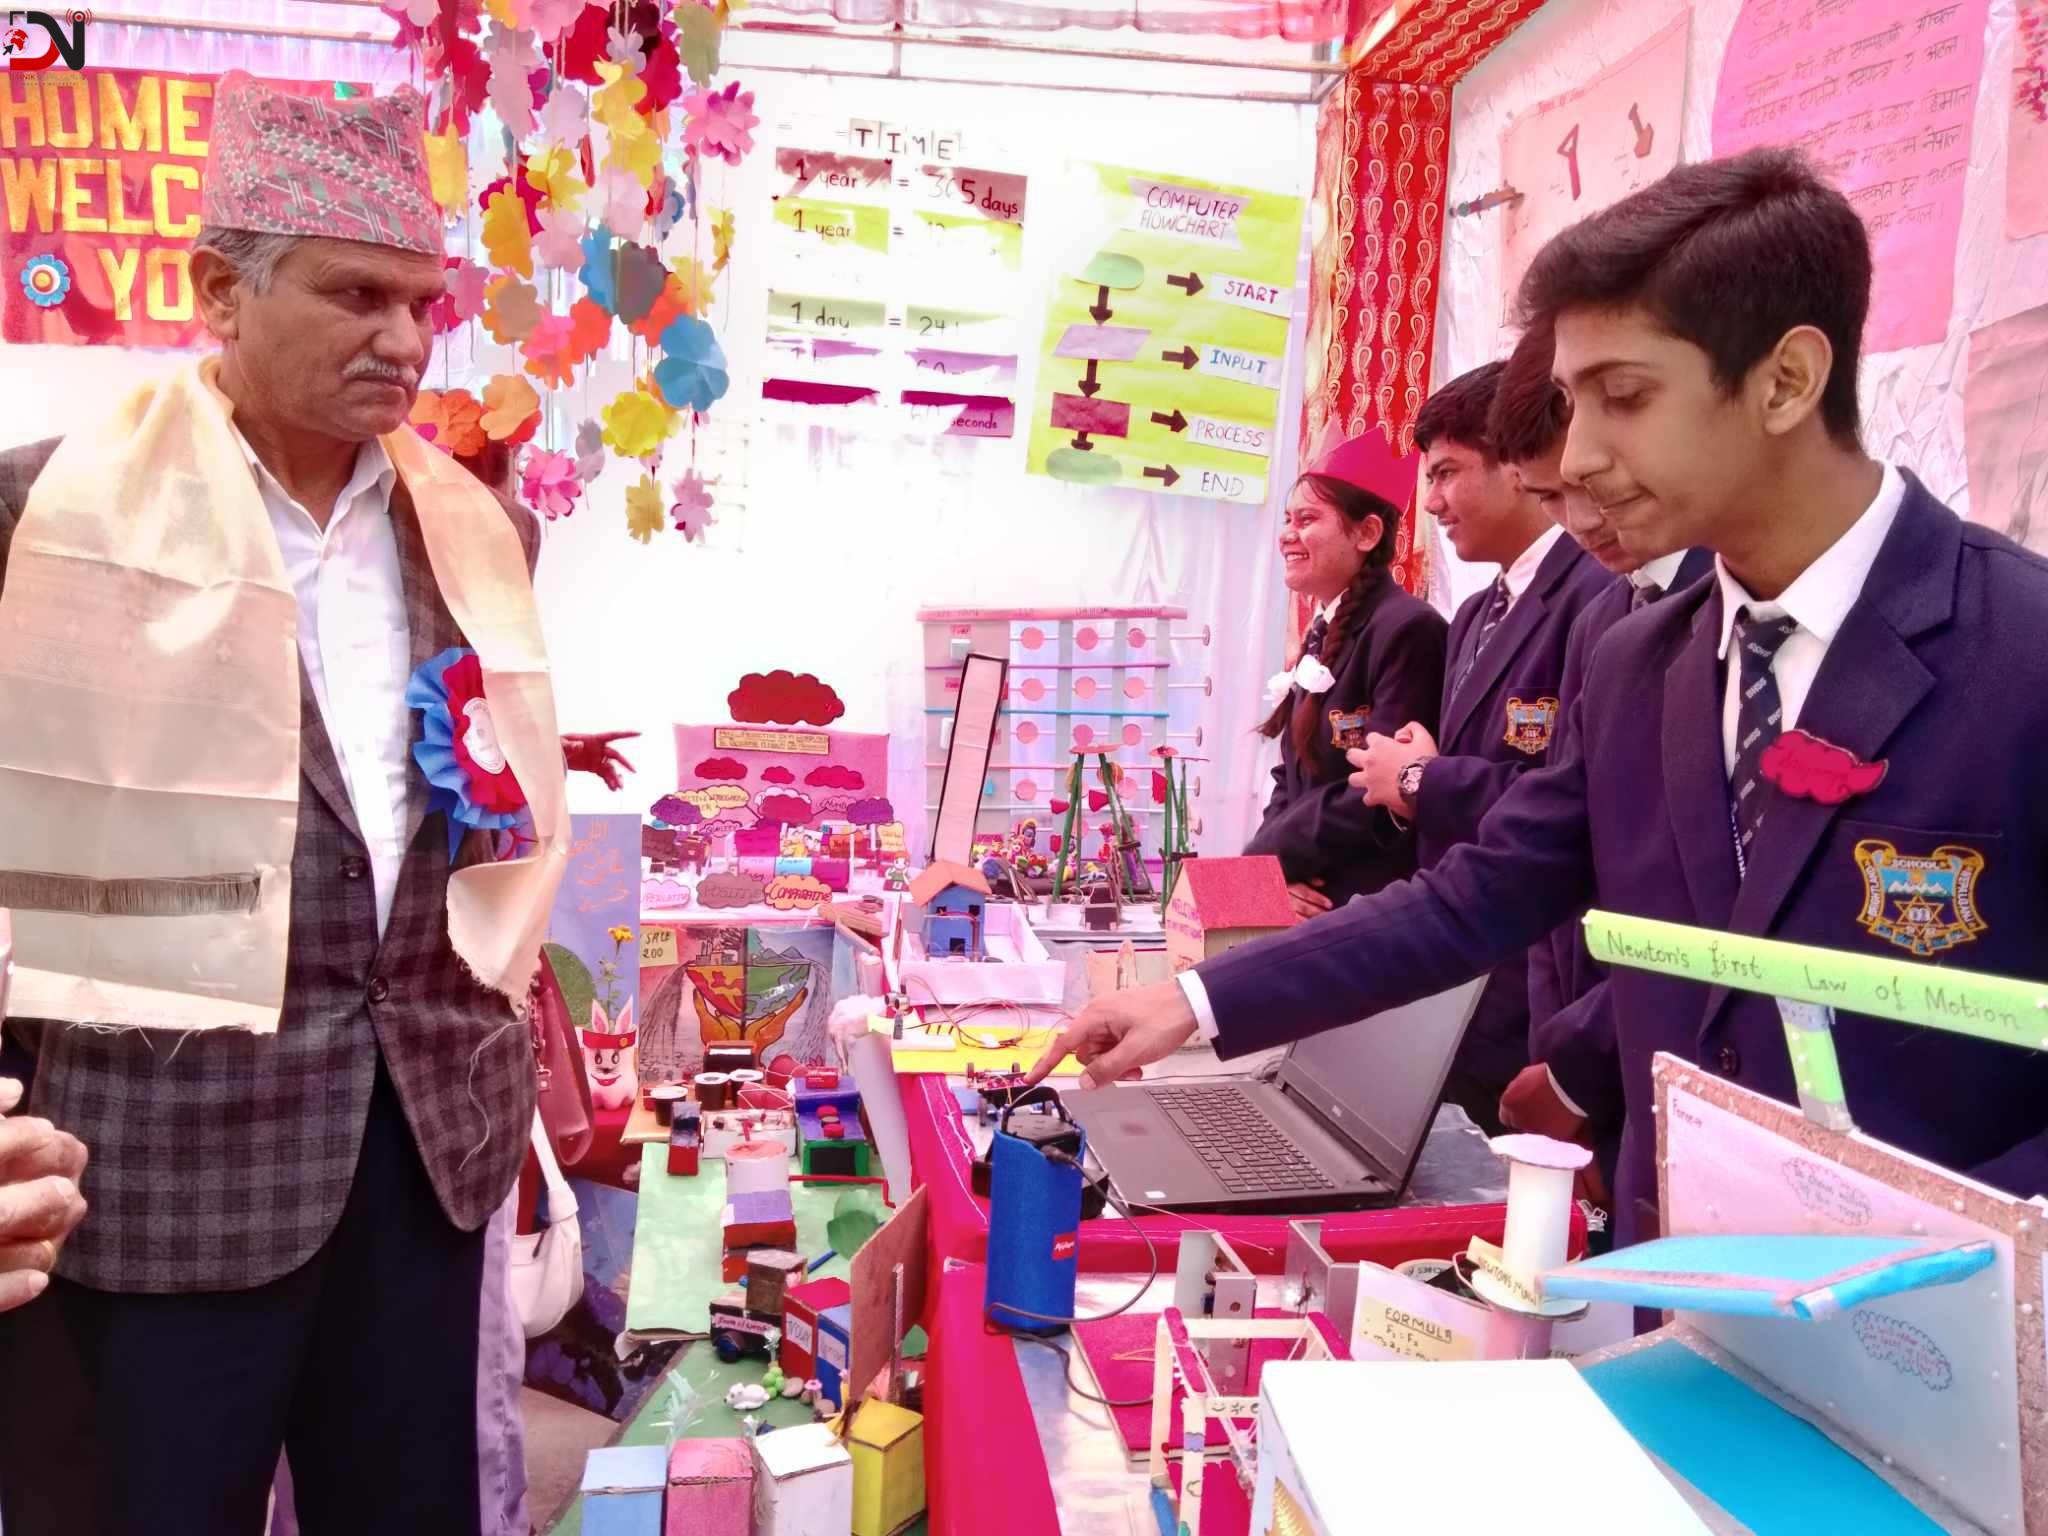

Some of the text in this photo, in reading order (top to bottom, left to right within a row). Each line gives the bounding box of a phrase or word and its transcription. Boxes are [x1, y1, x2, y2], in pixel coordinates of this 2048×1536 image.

[0, 71, 212, 157] HOME
[854, 128, 953, 160] TIME
[0, 157, 203, 238] WELC
[795, 158, 808, 181] 1
[819, 167, 857, 189] year
[981, 187, 1018, 220] days
[1146, 185, 1240, 222] COMPUTER
[793, 208, 805, 233] 1
[815, 220, 851, 239] year
[97, 247, 195, 321] YO
[1224, 280, 1280, 304] START
[790, 301, 802, 325] 1
[1210, 349, 1267, 374] INPUT
[1195, 419, 1265, 448] PROCESS
[1201, 471, 1245, 497] END
[1891, 857, 1940, 869] SCHOOL
[1607, 930, 1690, 969] Newton's
[1804, 965, 1848, 993] Law
[1875, 975, 1906, 1011] of
[1925, 985, 2020, 1030] Motion
[1384, 1306, 1453, 1342] FORMULA
